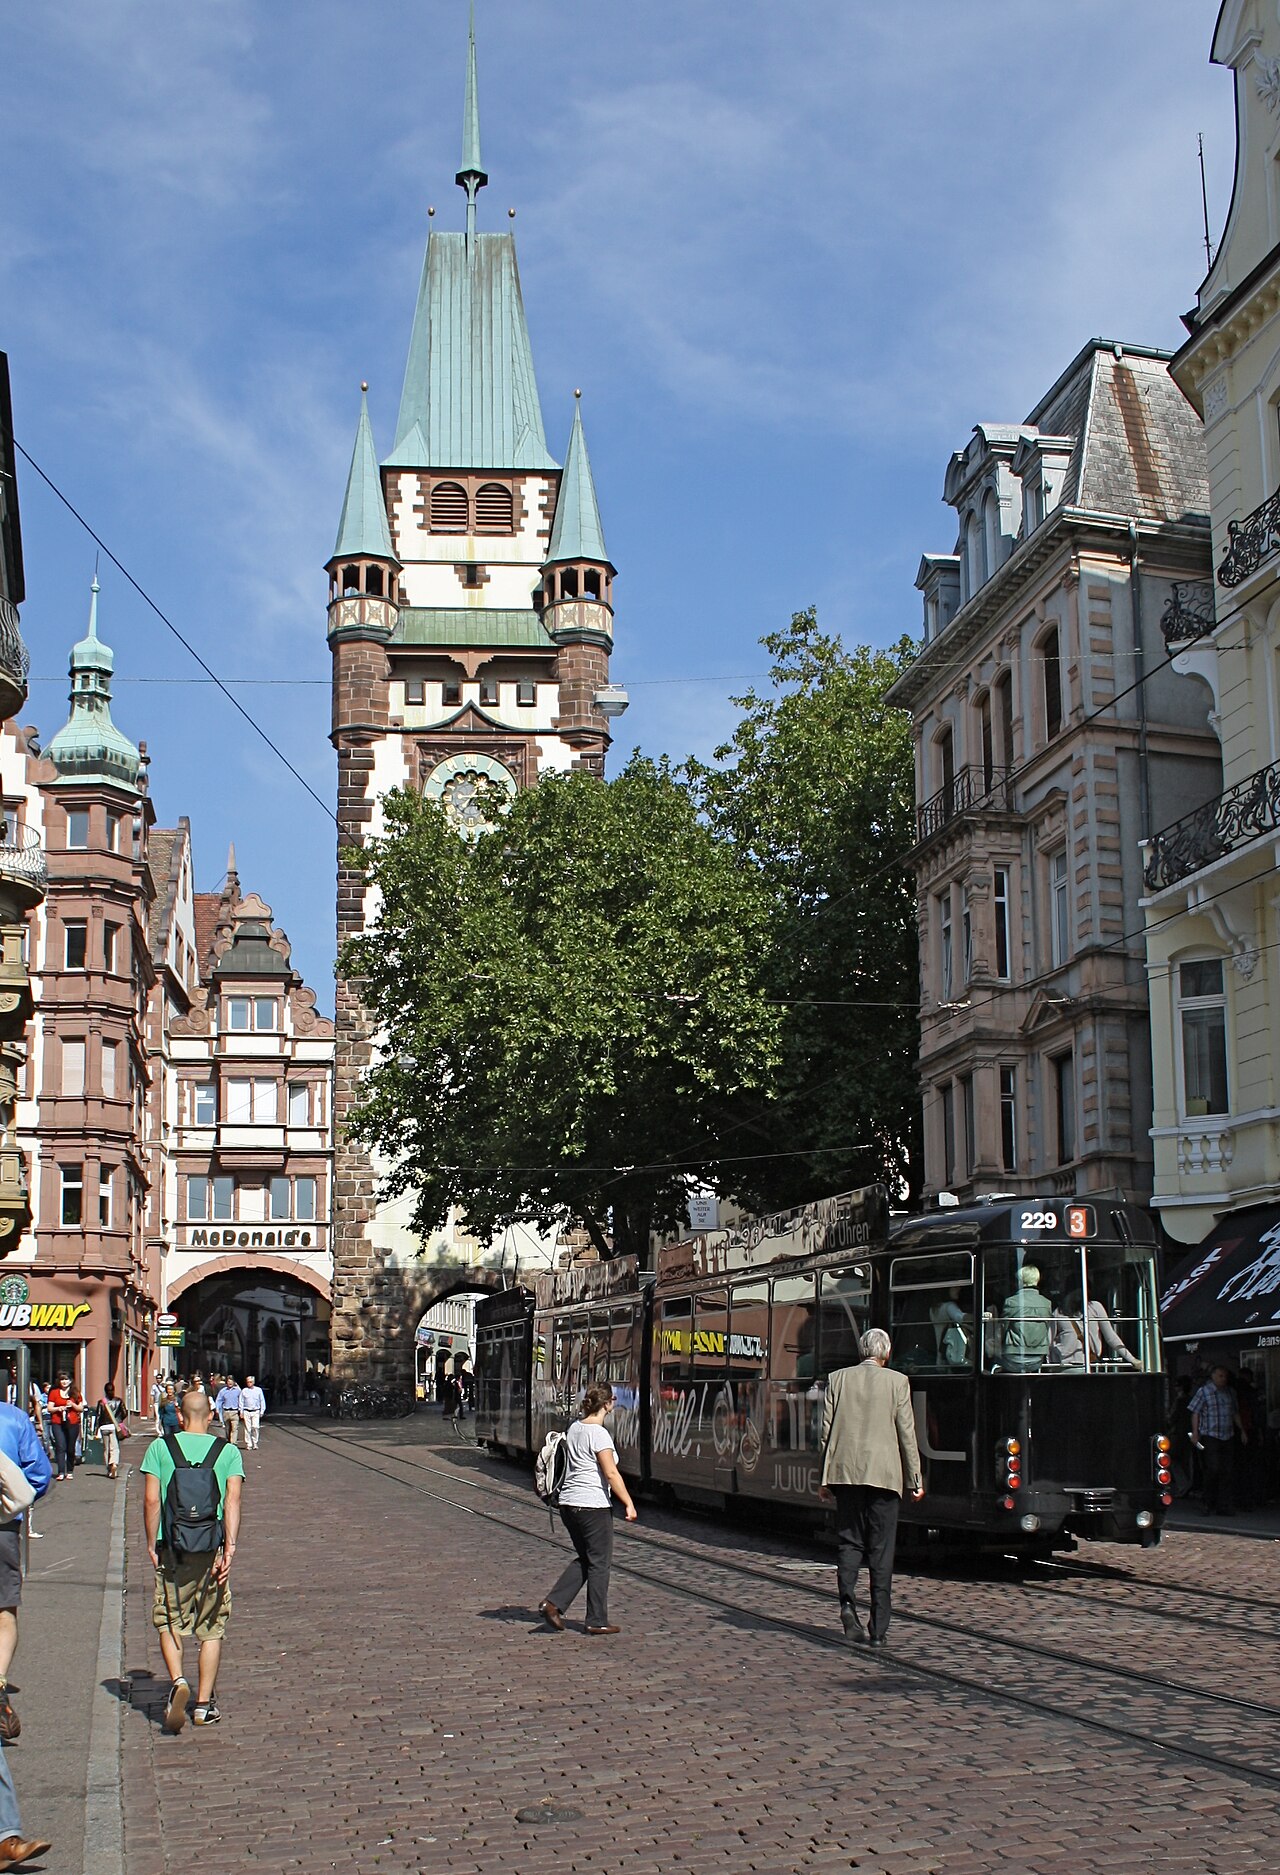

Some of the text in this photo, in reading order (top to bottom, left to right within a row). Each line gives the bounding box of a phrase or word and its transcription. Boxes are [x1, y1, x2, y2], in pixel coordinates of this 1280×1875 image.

[1020, 1212, 1058, 1230] 229
[1070, 1211, 1085, 1234] 3
[191, 1229, 312, 1247] McDonald's
[837, 1221, 870, 1247] Uhren
[0, 1302, 92, 1328] UBWAY
